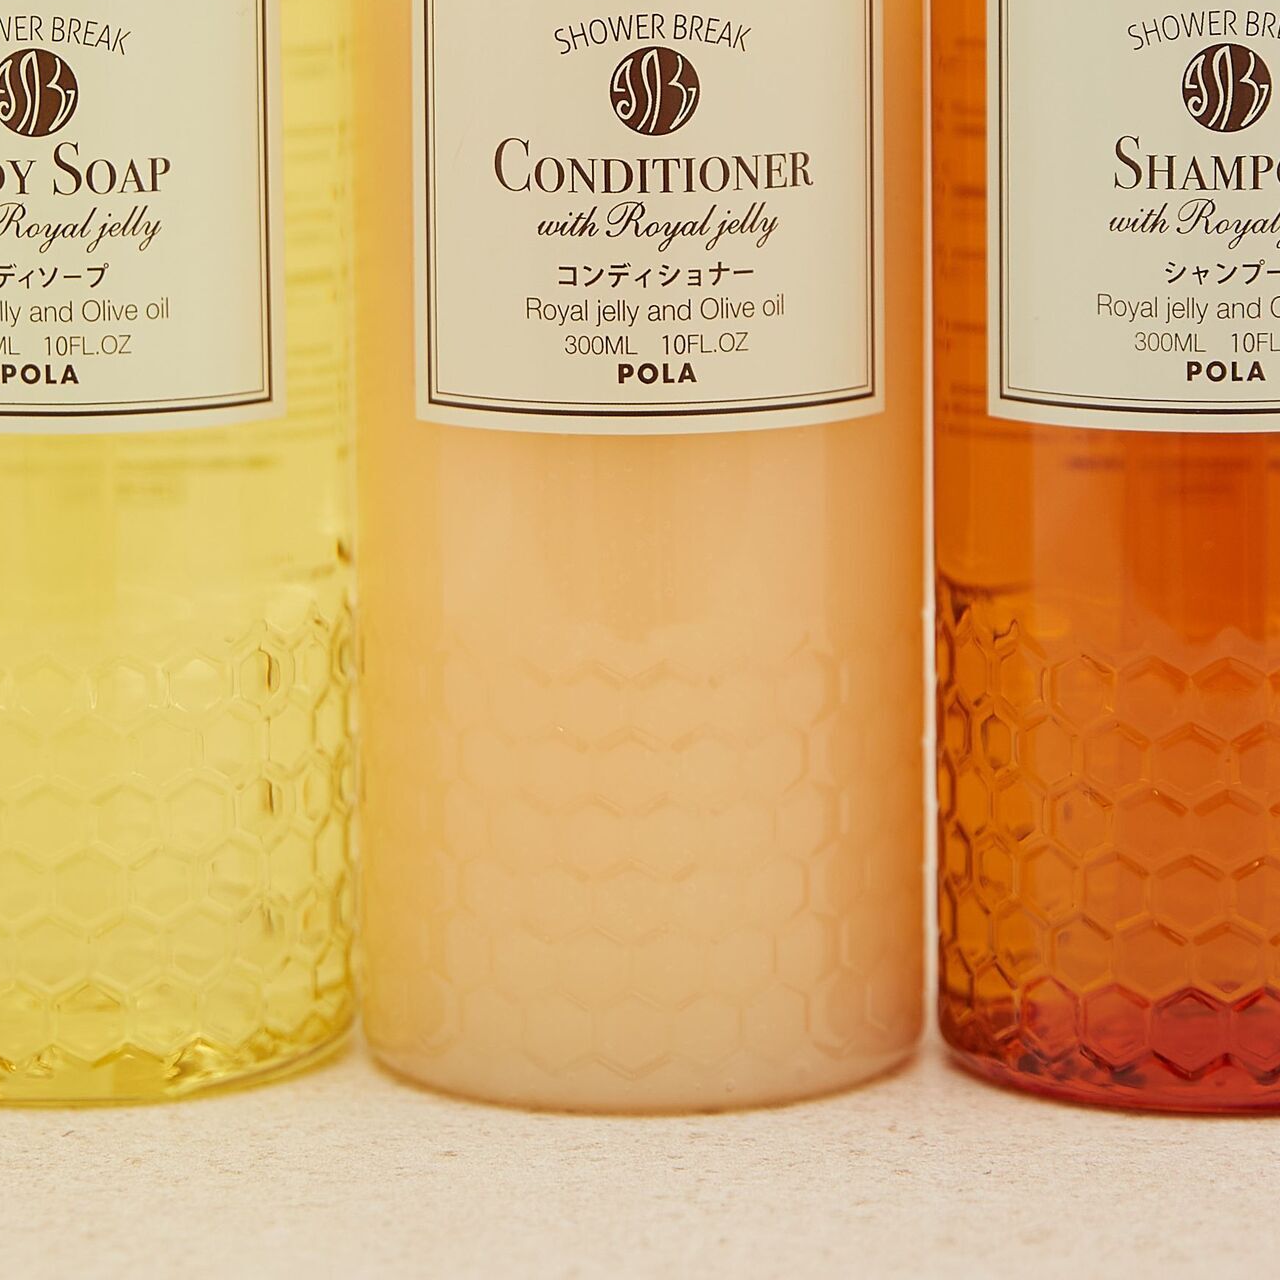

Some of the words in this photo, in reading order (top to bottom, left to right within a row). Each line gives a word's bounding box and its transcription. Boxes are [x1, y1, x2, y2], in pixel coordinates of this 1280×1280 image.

[51, 16, 132, 56] BREAK
[554, 13, 666, 55] SHOWER
[673, 14, 752, 53] BREAK
[1127, 10, 1238, 52] SHOWER
[84, 204, 163, 253] jelly
[536, 206, 601, 238] with
[604, 200, 712, 253] Royal
[703, 201, 780, 252] jelly
[1108, 202, 1171, 234] with
[557, 260, 755, 289] コンディショナー
[29, 299, 74, 324] and
[81, 298, 139, 323] Olive
[145, 296, 169, 321] oil
[525, 296, 589, 327] Royal
[594, 298, 641, 328] jelly
[647, 297, 692, 323] and
[699, 296, 756, 321] Olive
[762, 292, 785, 317] oil
[1096, 292, 1158, 323] Royal
[1164, 295, 1209, 325] jelly
[1216, 296, 1262, 320] and
[43, 333, 133, 357] 10FL.OZ
[564, 334, 639, 356] 300ML
[661, 331, 750, 356] 10FL.OZ
[1133, 331, 1208, 353] 300ML
[0, 363, 80, 386] POLA
[617, 361, 698, 385] POLA
[1186, 360, 1267, 383] POLA
